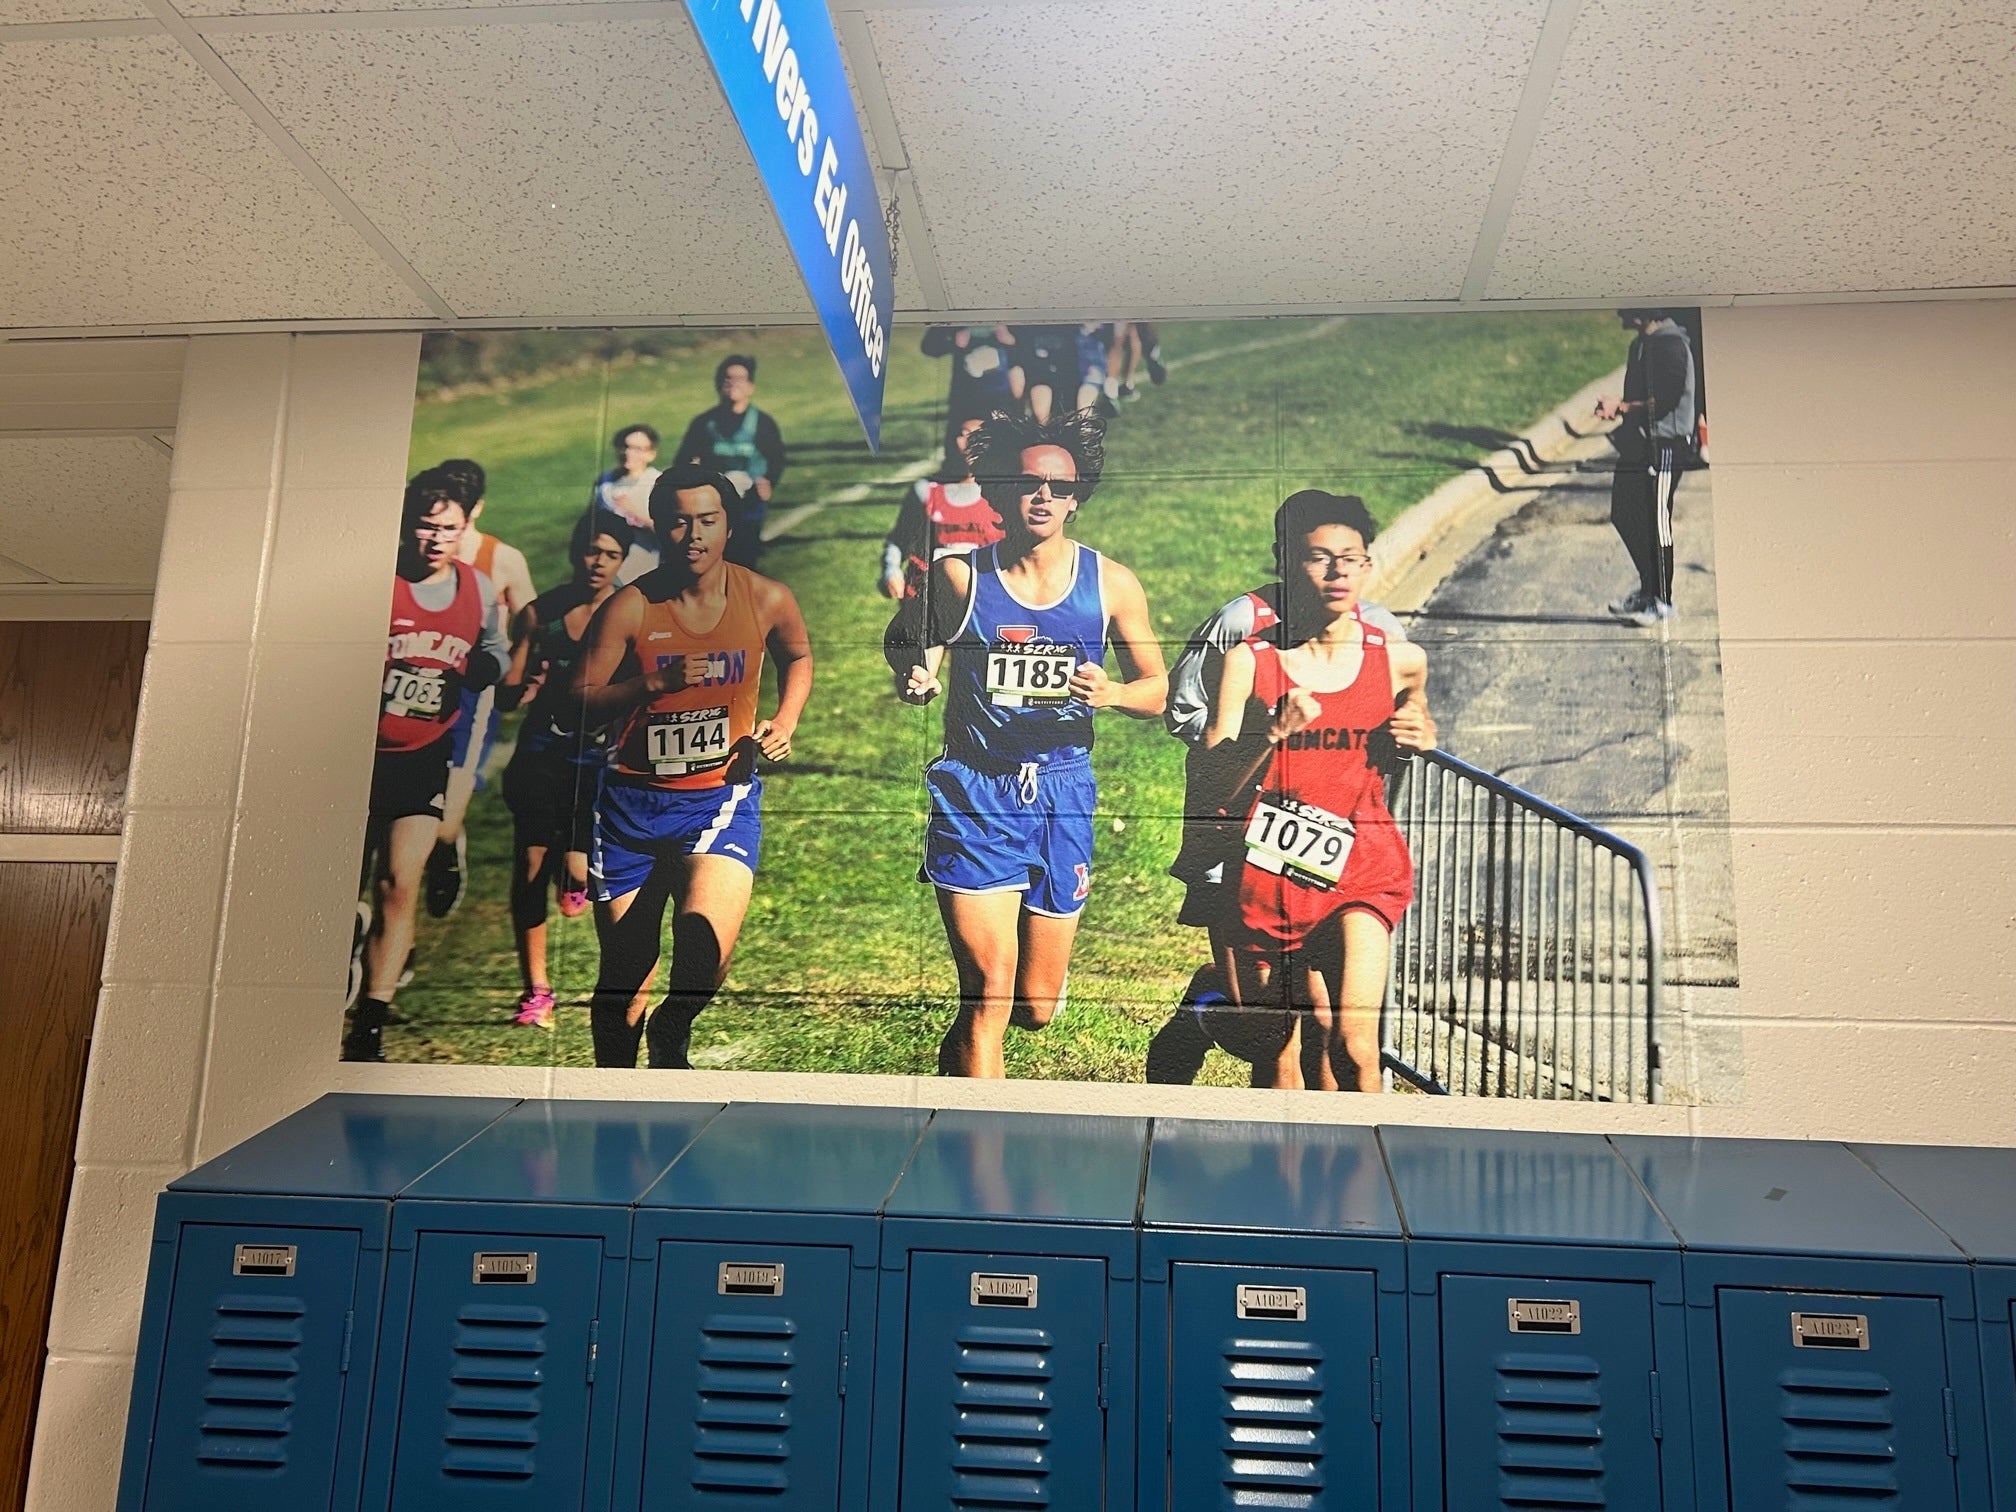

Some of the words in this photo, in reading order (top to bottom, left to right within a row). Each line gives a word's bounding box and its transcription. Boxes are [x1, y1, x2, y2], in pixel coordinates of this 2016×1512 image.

[740, 0, 819, 177] ivers
[813, 135, 848, 257] Ed
[841, 218, 884, 379] Office
[993, 657, 1069, 690] 1185
[653, 722, 726, 757] 1144
[1277, 727, 1372, 752] OMCAT
[1259, 811, 1343, 866] 1079
[988, 1281, 1022, 1295] A1020
[1255, 1293, 1288, 1307] A1021
[1528, 1307, 1563, 1320] A1022
